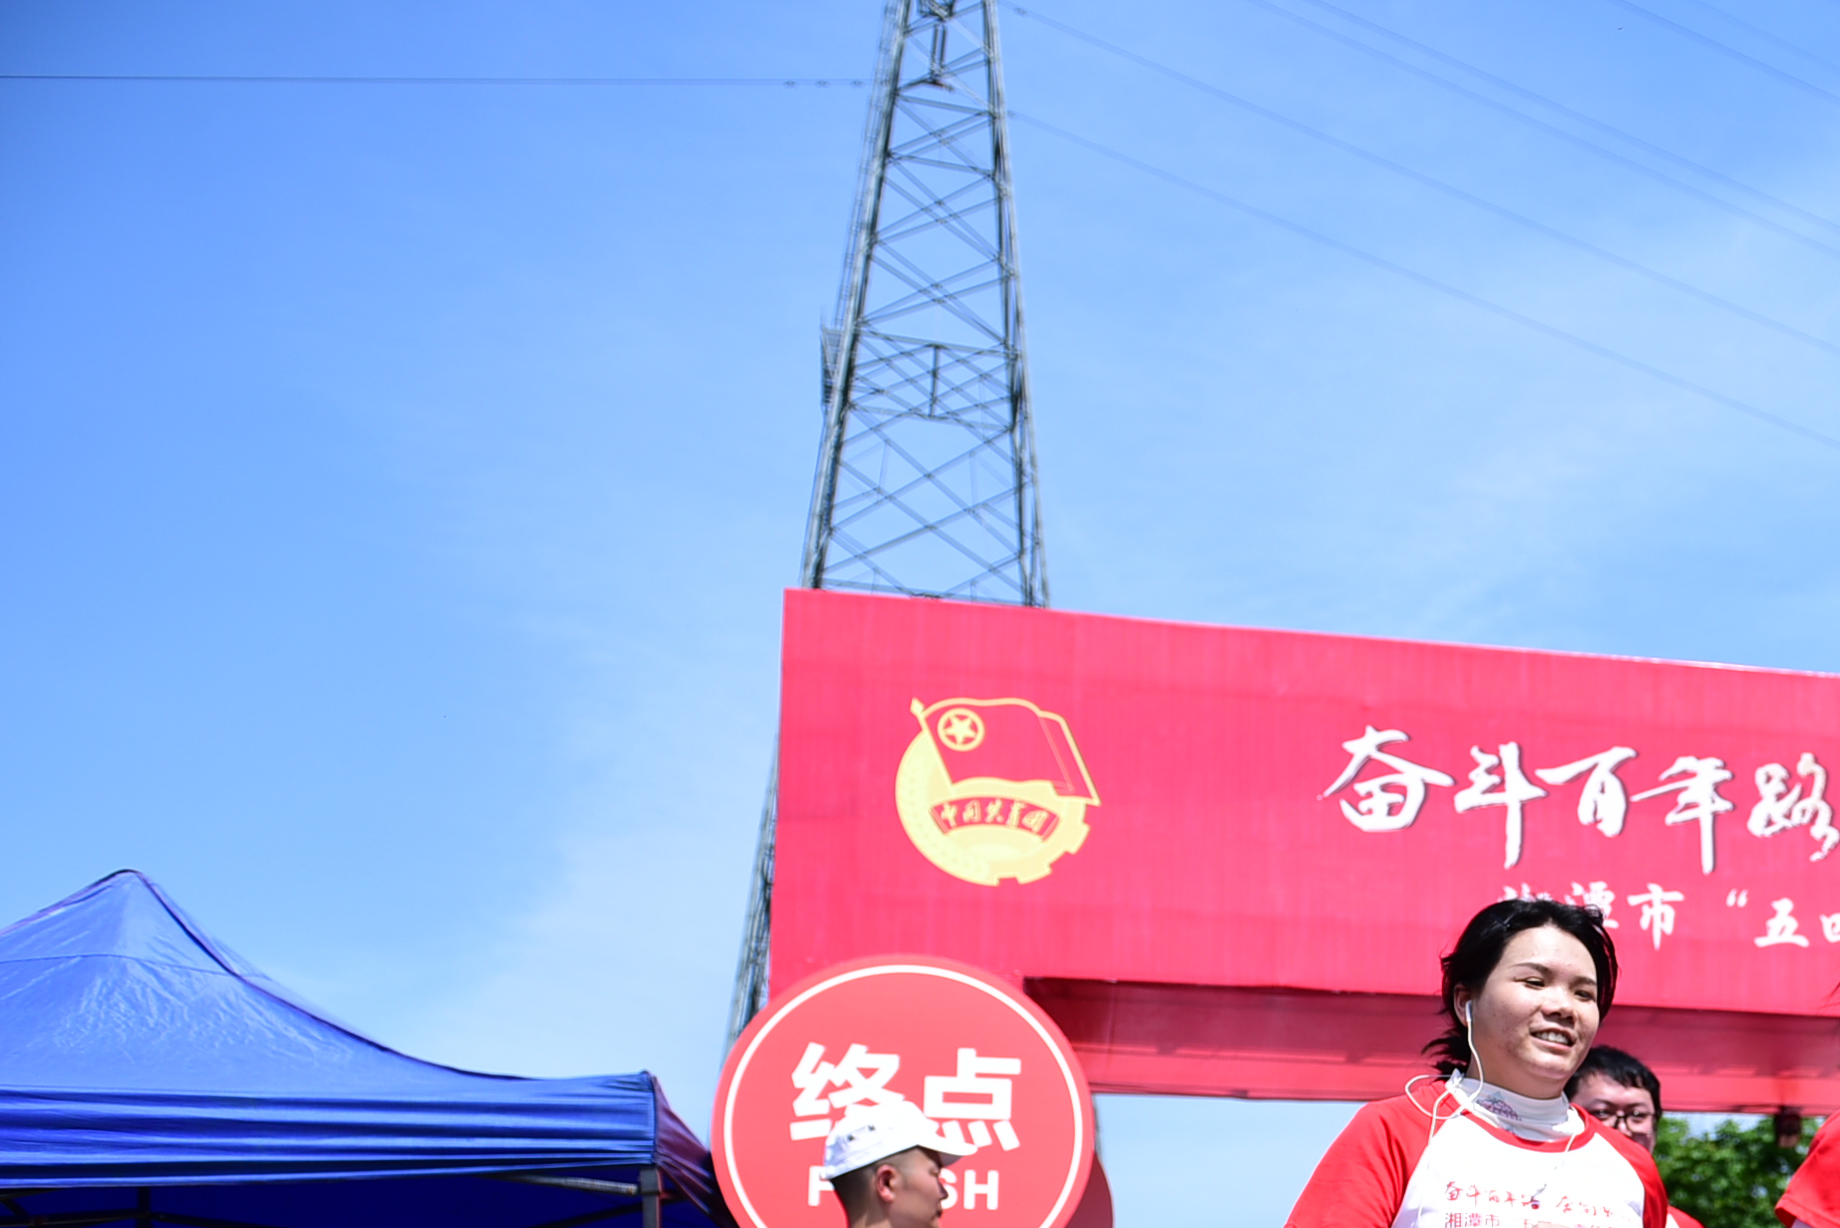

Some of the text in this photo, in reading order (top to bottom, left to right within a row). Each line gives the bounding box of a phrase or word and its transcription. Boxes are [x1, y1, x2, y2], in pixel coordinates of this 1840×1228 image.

[1318, 725, 1840, 875] 奋斗百年路
[789, 1041, 1022, 1151] 终点
[807, 1165, 1000, 1211] FSH
